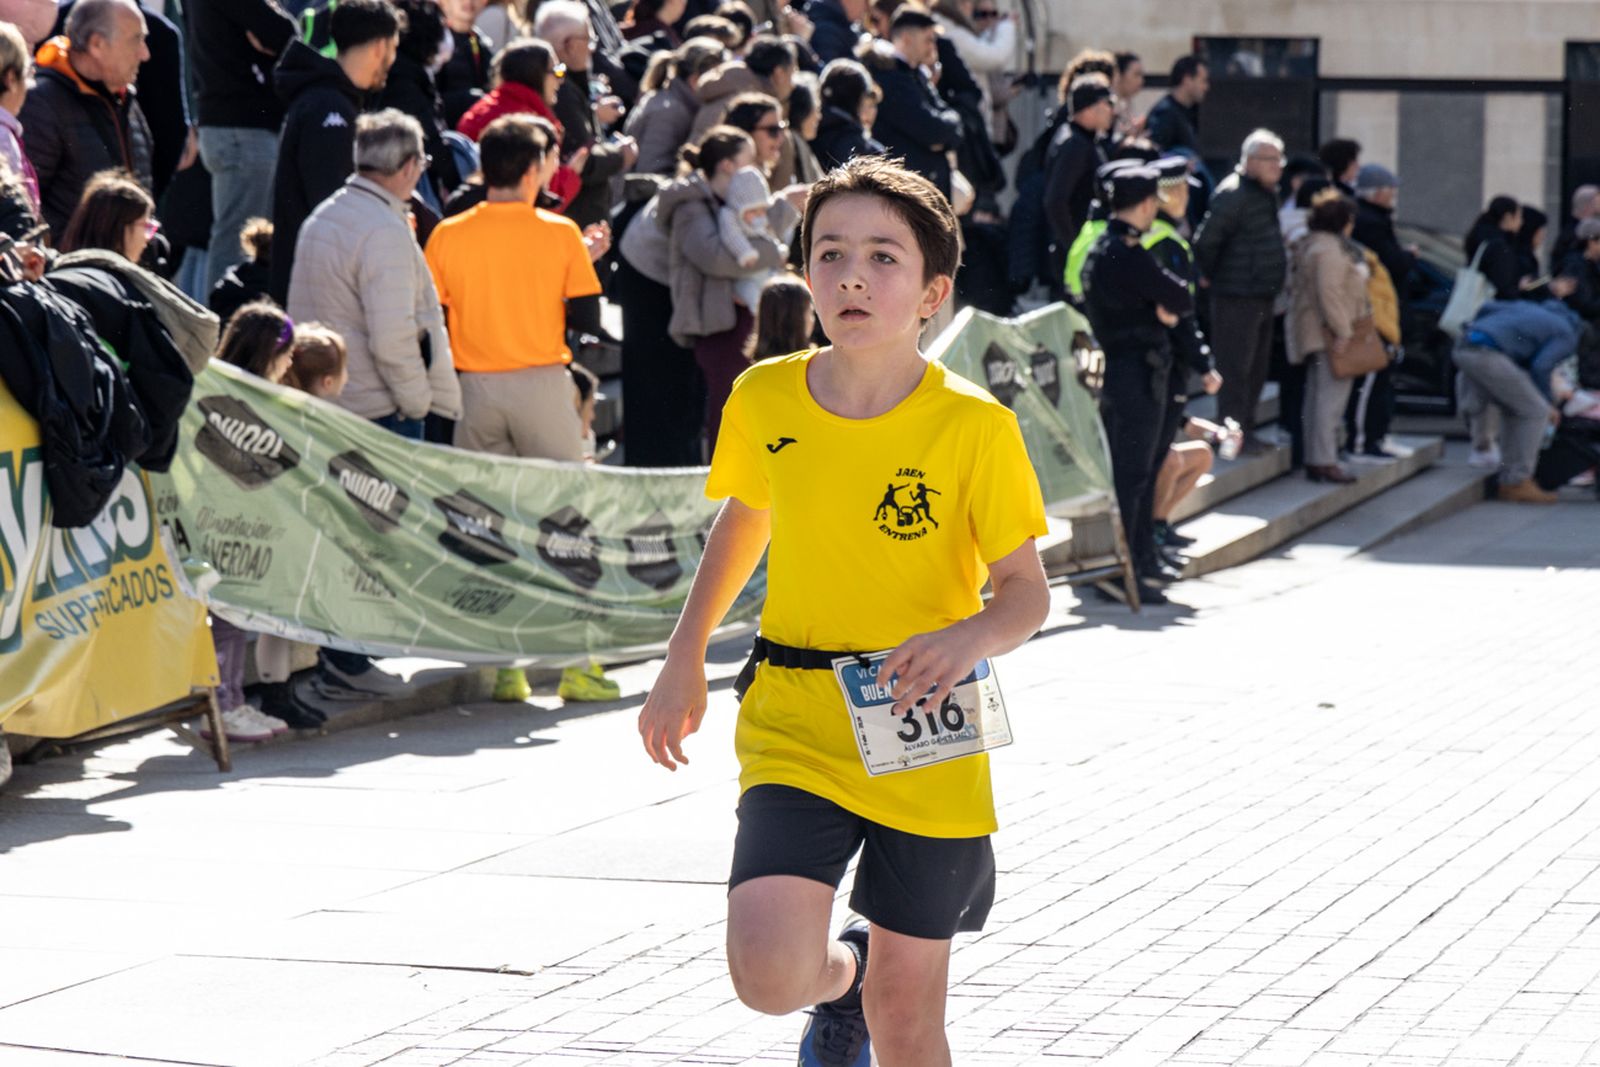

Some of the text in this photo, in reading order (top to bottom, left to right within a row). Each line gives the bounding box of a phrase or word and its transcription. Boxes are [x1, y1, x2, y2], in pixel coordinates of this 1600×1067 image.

[896, 467, 926, 479] JAEN
[878, 523, 928, 541] ENTRENA
[891, 692, 965, 743] 316
